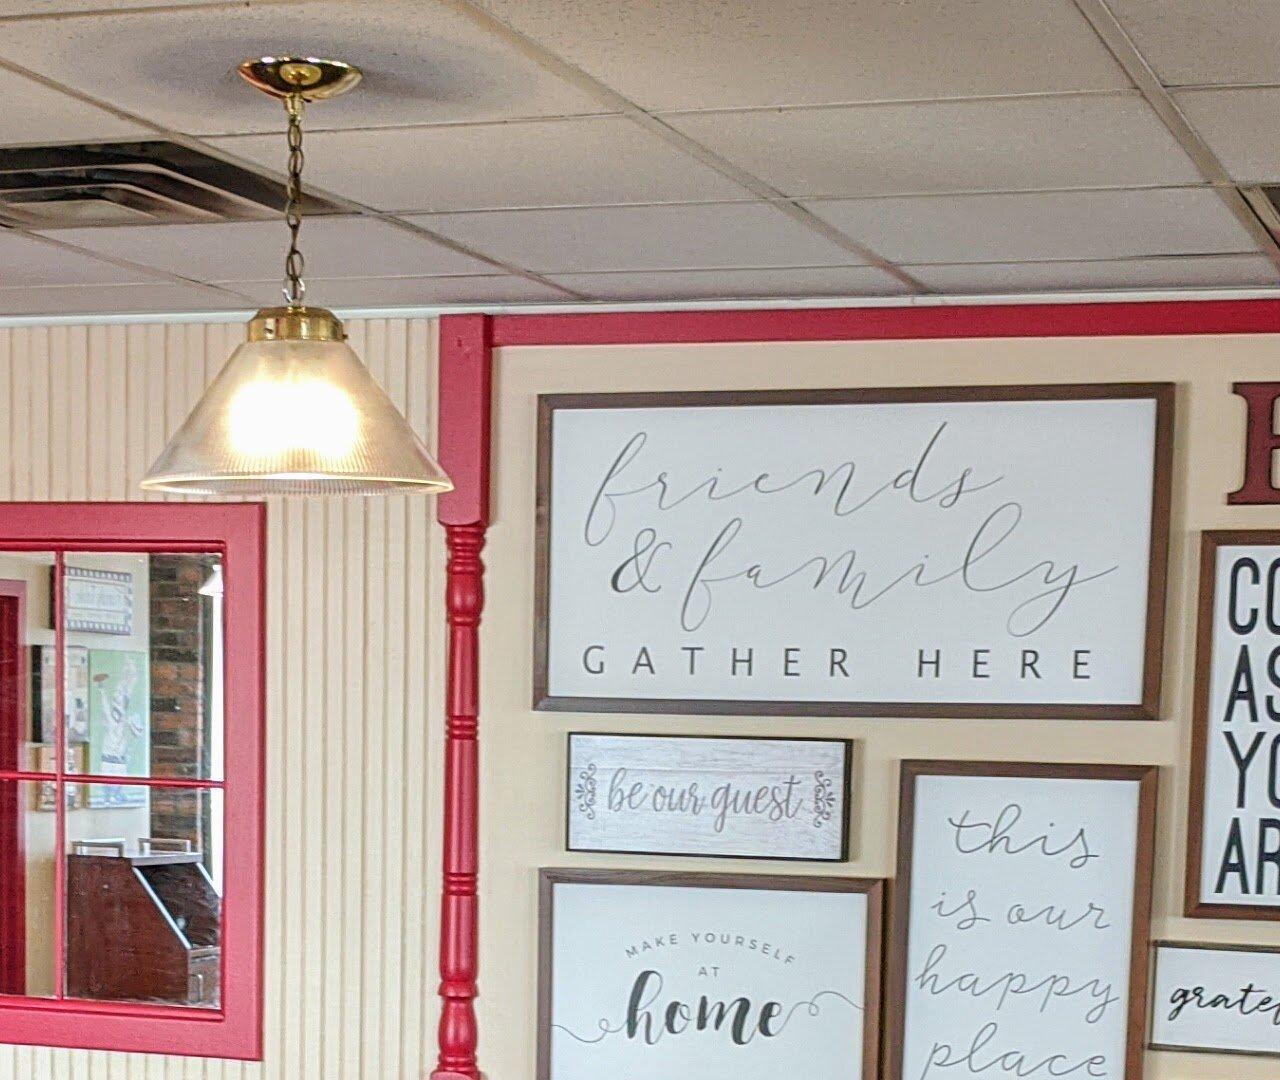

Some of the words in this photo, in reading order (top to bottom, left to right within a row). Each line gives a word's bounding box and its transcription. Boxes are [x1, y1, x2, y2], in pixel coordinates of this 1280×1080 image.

[585, 421, 1004, 546] friends
[611, 528, 672, 593] &
[681, 502, 1119, 638] family
[582, 645, 851, 678] GATHER
[918, 647, 1093, 680] HERE
[608, 767, 645, 812] be
[652, 782, 705, 816] our
[711, 774, 801, 834] guest
[949, 803, 1100, 869] this
[932, 889, 991, 929] is
[1007, 901, 1111, 930] our
[625, 934, 678, 959] MAKE
[691, 932, 795, 965] YOURSELF
[698, 966, 720, 978] AT
[624, 970, 786, 1046] home
[916, 943, 1121, 1024] happy
